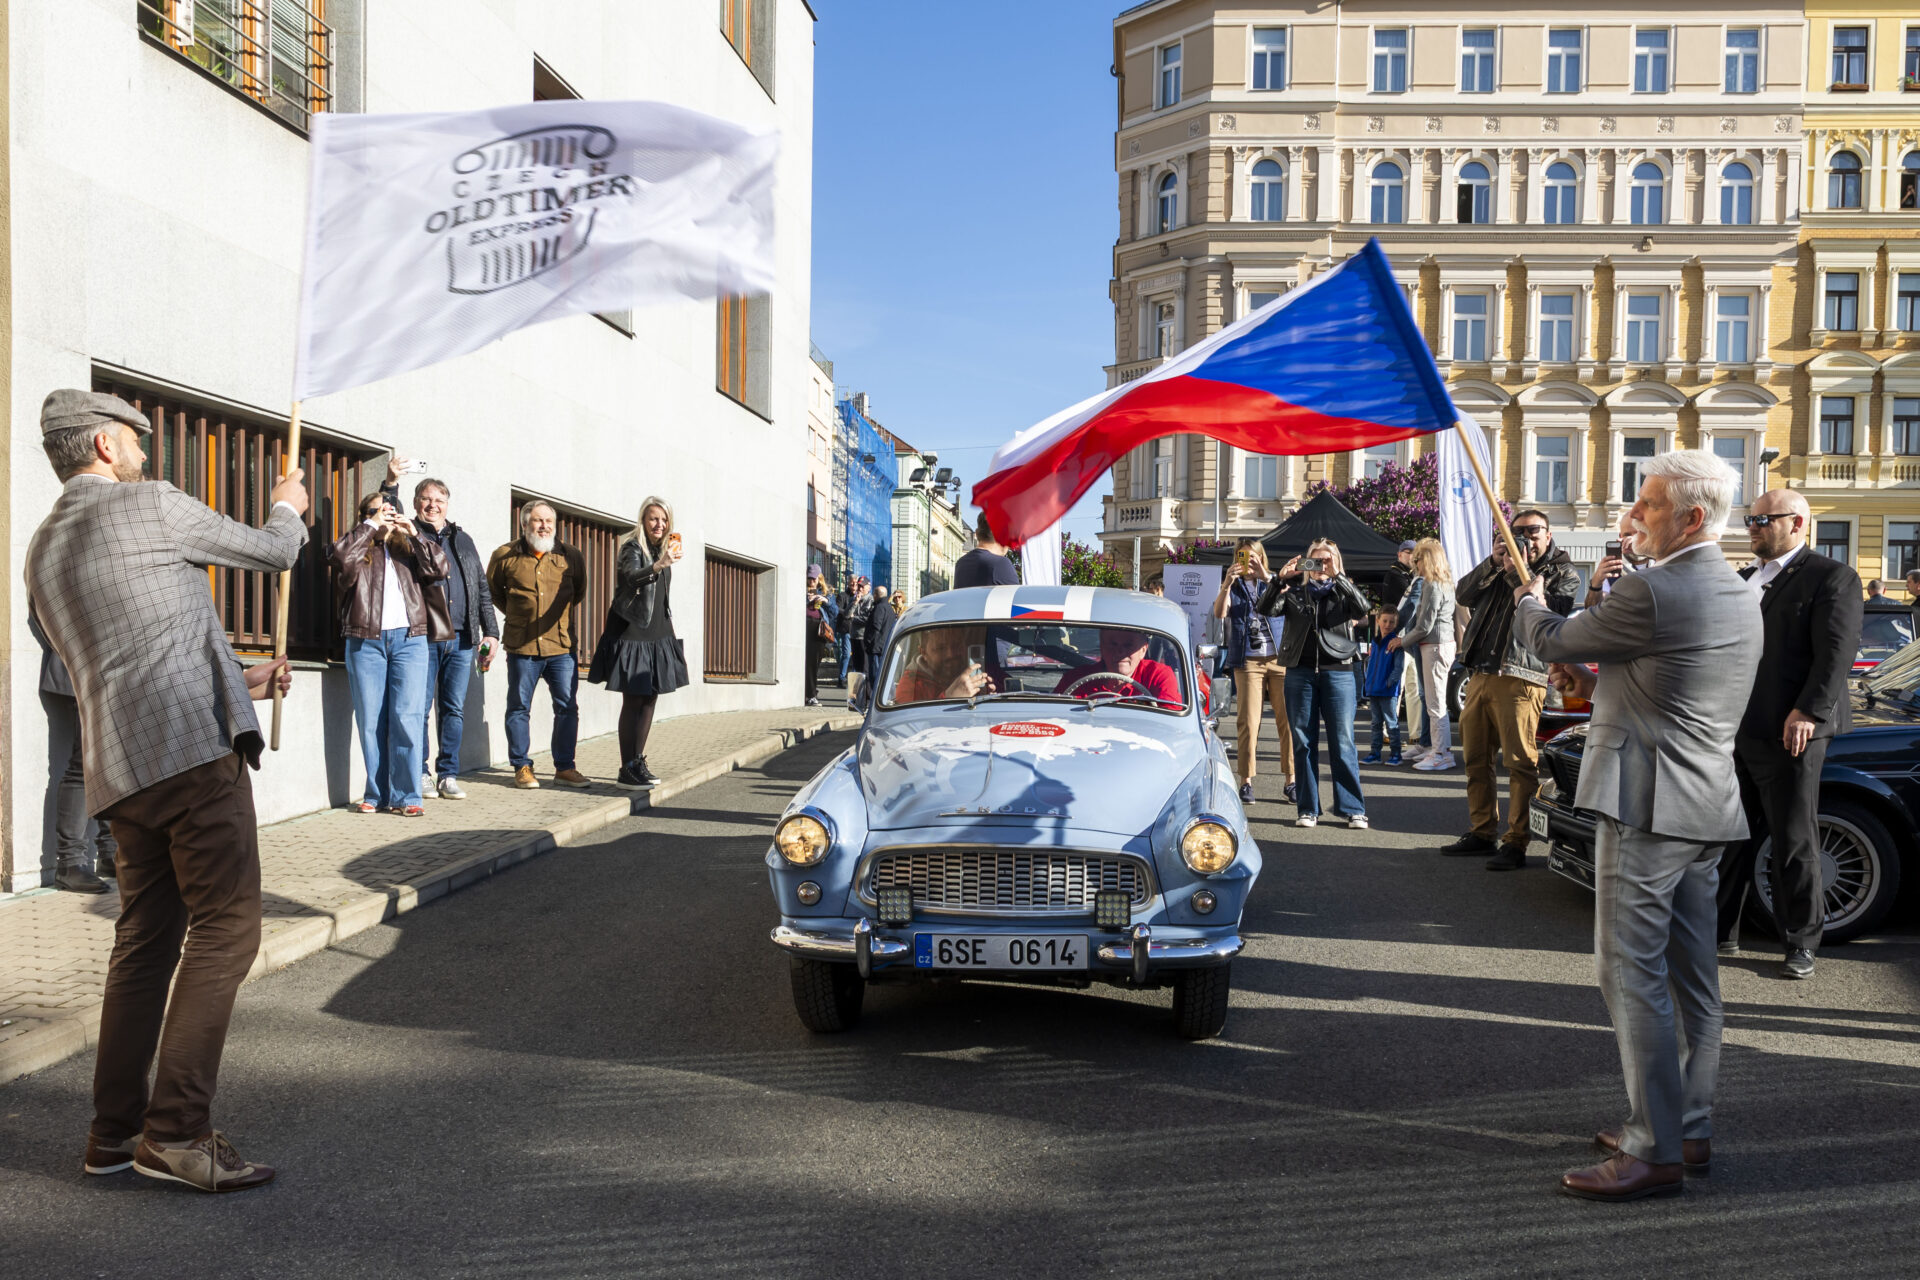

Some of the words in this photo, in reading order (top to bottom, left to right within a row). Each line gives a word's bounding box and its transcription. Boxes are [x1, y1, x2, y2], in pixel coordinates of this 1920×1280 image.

[425, 174, 632, 233] OLDTIMER
[918, 955, 931, 964] CZ
[938, 938, 987, 965] 6SE
[1008, 938, 1075, 965] 0614
